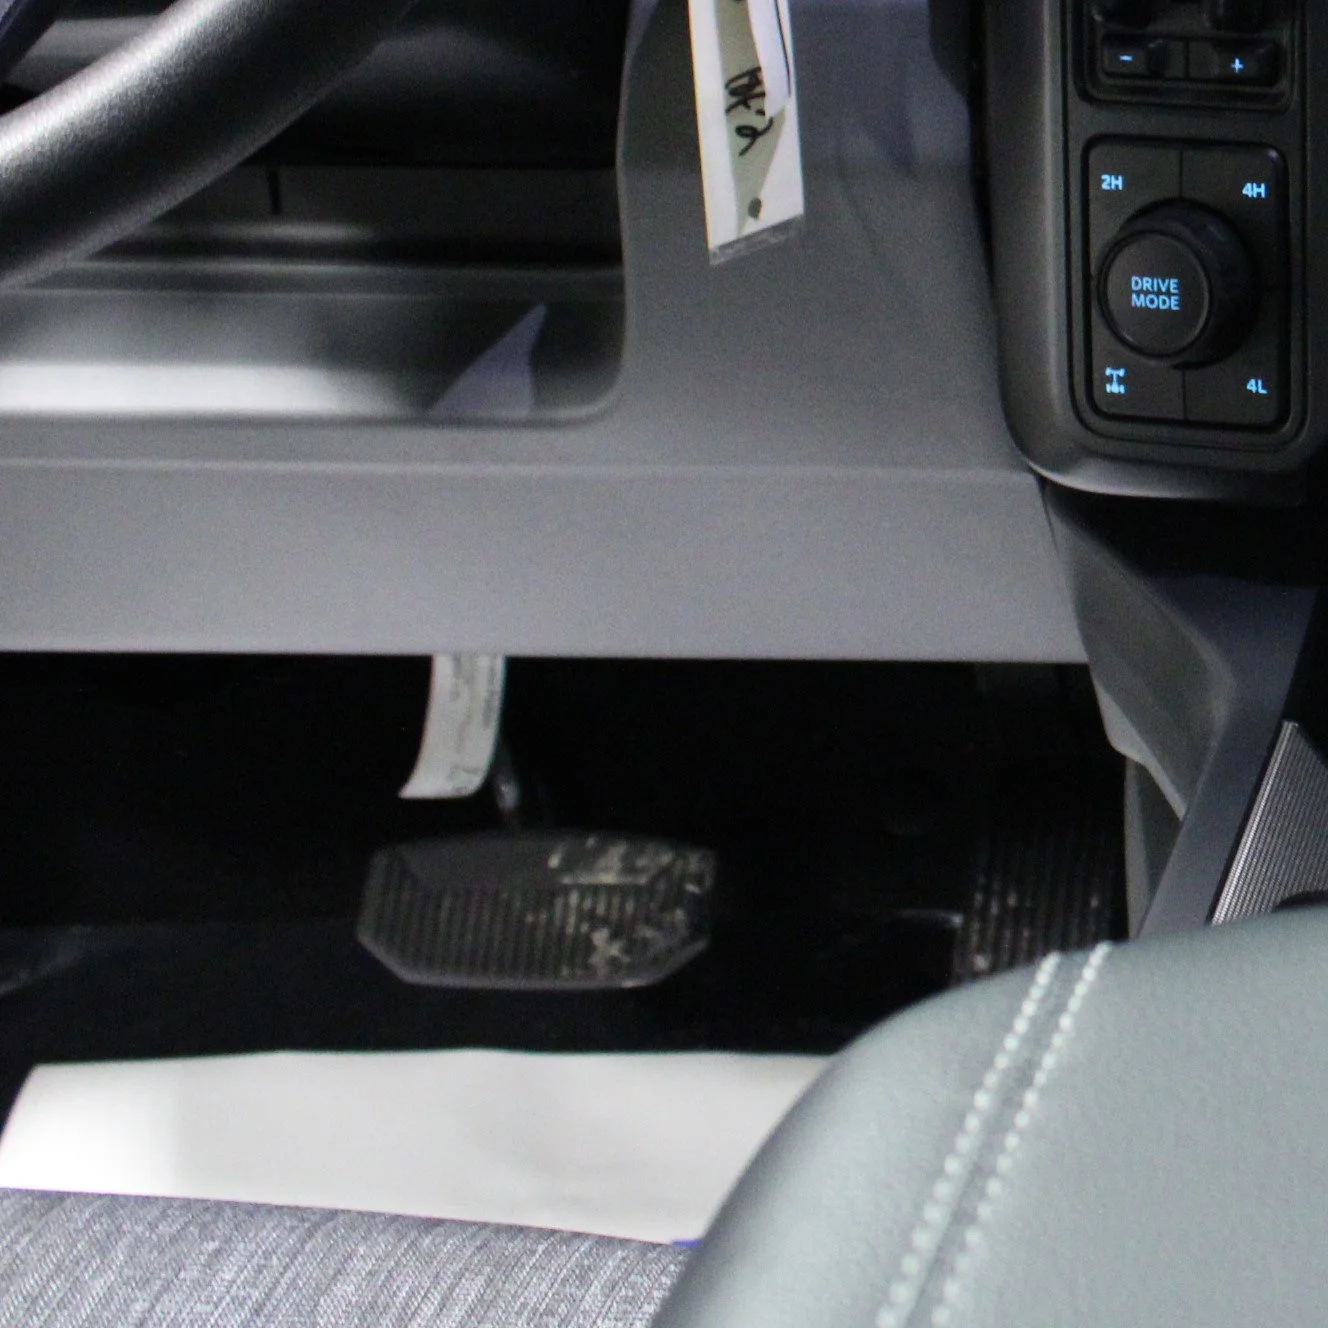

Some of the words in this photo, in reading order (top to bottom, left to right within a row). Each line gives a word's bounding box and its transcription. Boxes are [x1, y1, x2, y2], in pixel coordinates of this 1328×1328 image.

[1101, 174, 1123, 191] 2H
[1241, 182, 1266, 198] 4H
[1131, 275, 1178, 294] DRIVE
[1131, 293, 1179, 311] MODE
[1246, 378, 1268, 395] 4L
